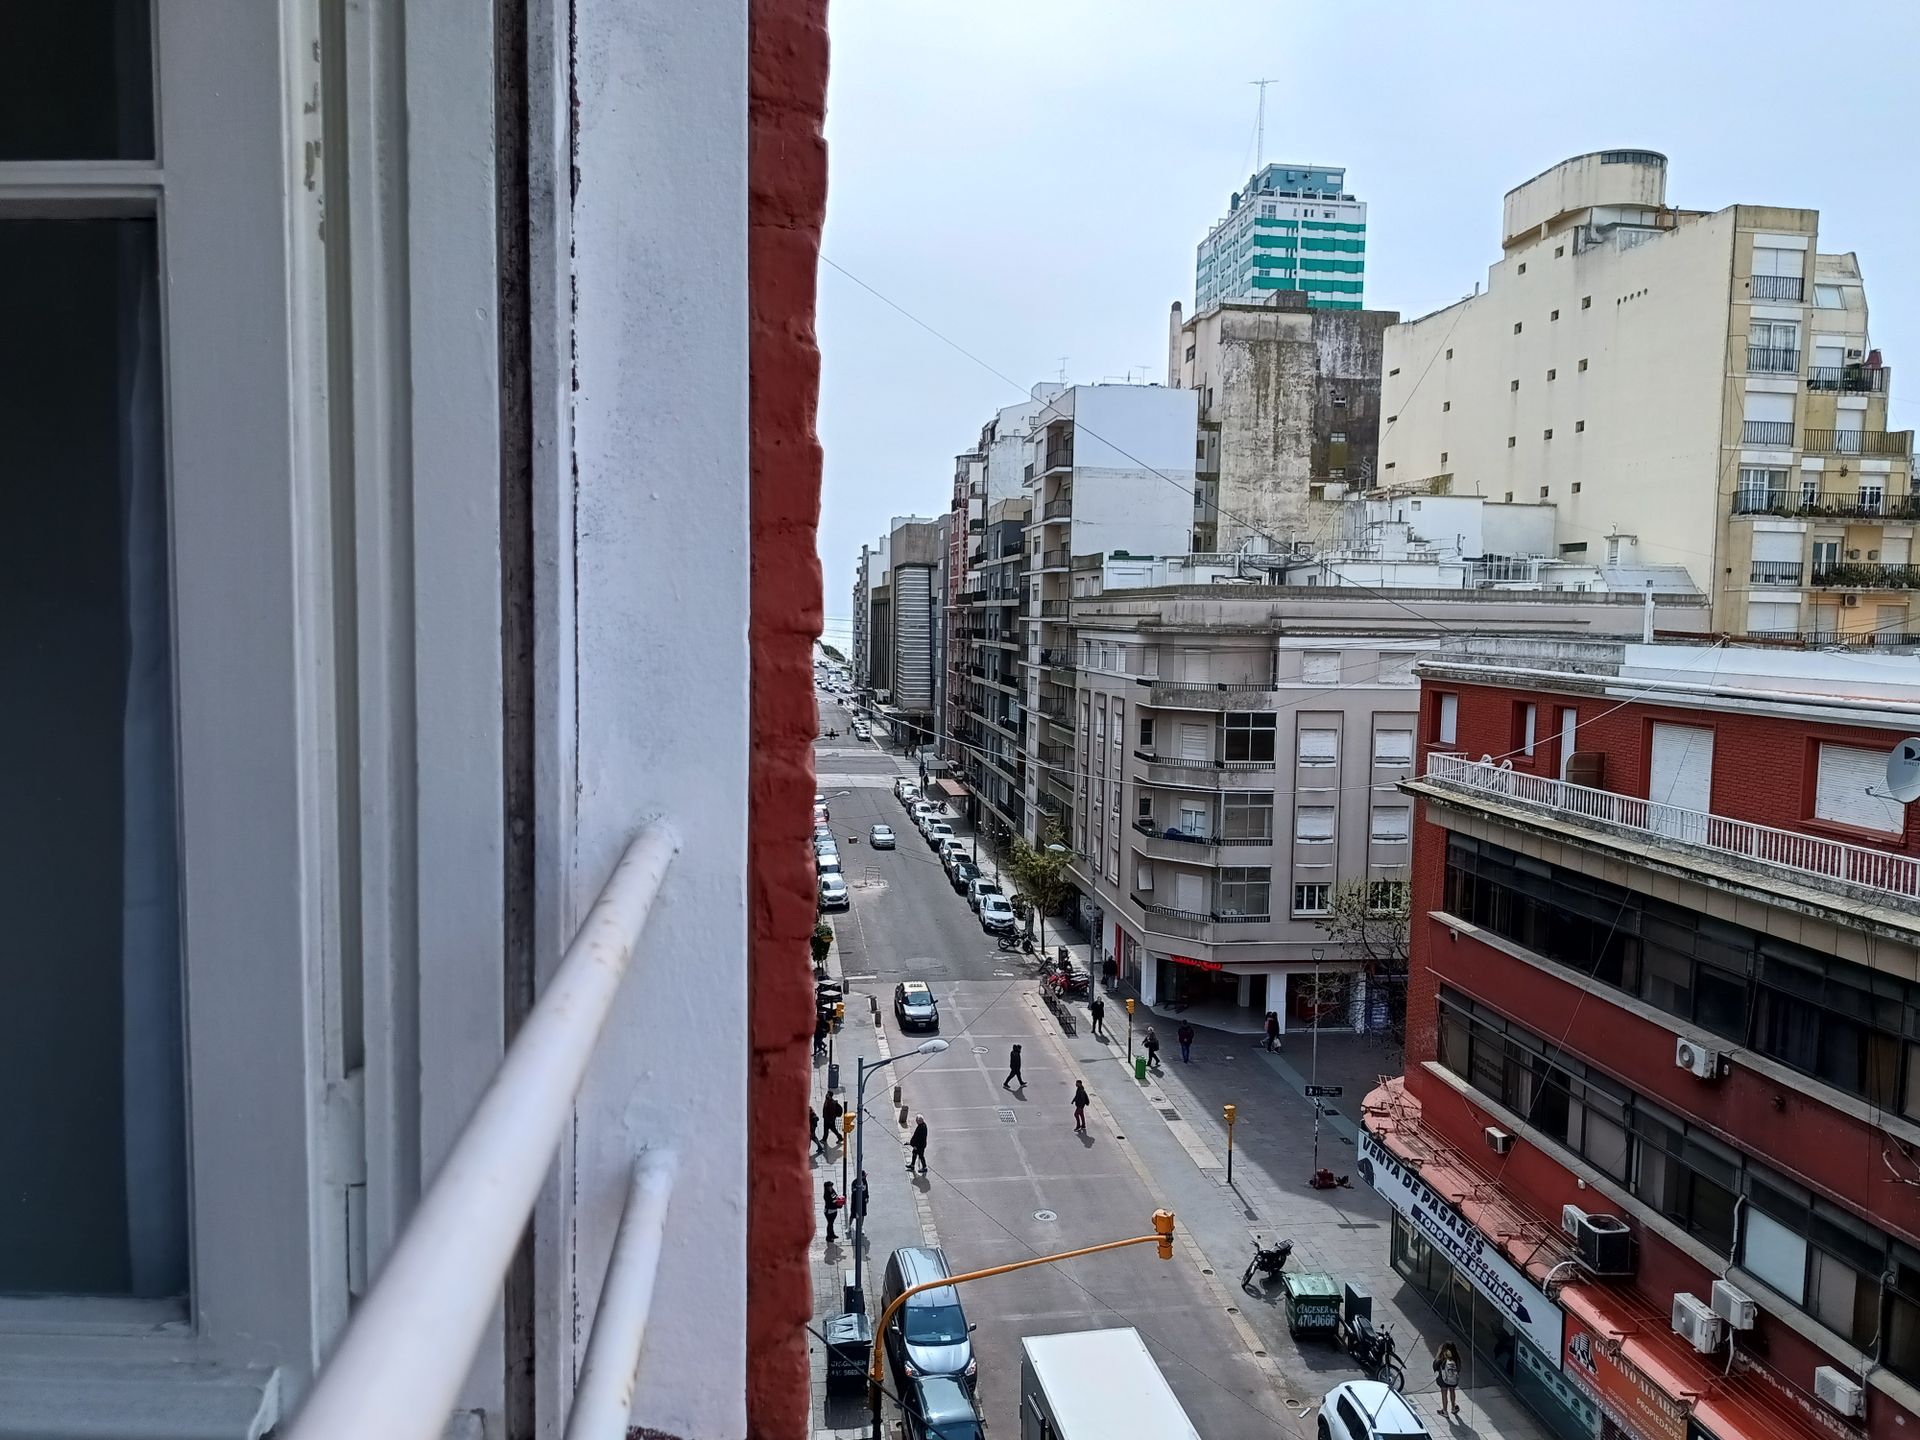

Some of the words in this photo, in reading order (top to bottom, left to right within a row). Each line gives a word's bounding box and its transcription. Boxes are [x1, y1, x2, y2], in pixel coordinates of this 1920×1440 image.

[1362, 1136, 1401, 1180] VENTA
[1402, 1172, 1421, 1197] DE
[1420, 1189, 1485, 1255] PASAJES
[1419, 1212, 1450, 1246] TODOS
[1449, 1245, 1469, 1264] LOS
[1468, 1260, 1520, 1313] DESTINOS
[1466, 1246, 1489, 1270] TODO
[1489, 1269, 1500, 1282] EL
